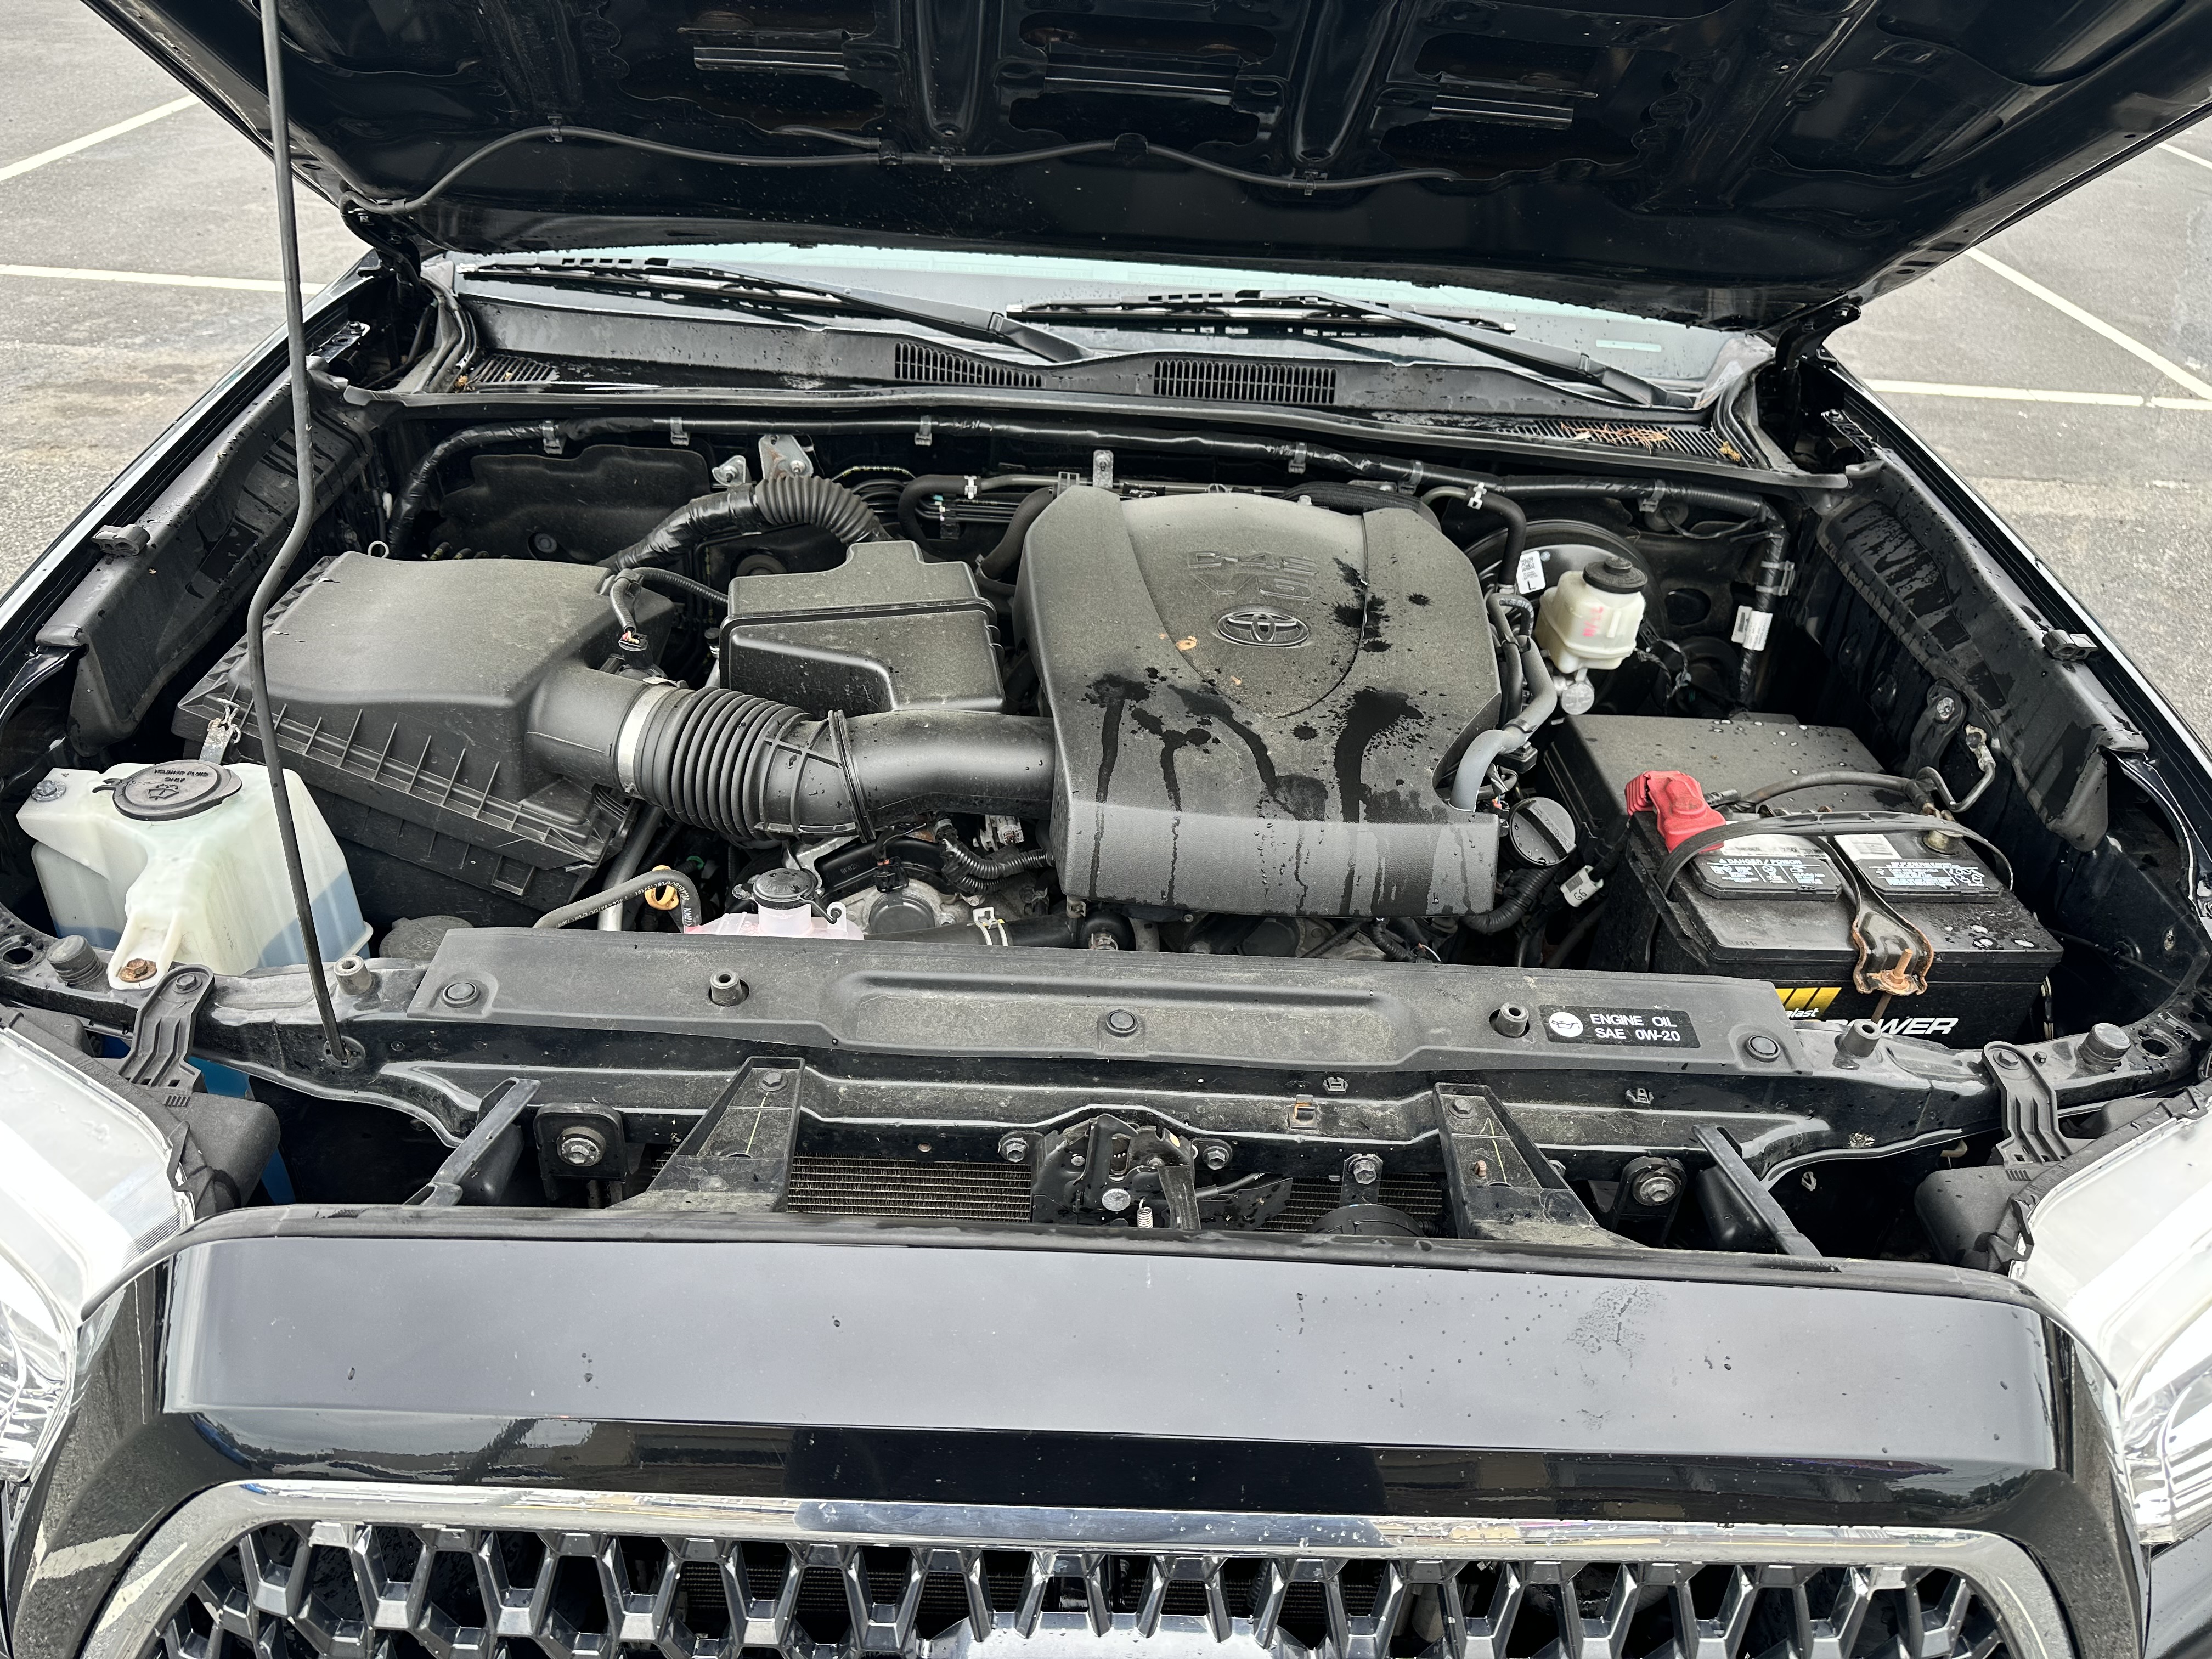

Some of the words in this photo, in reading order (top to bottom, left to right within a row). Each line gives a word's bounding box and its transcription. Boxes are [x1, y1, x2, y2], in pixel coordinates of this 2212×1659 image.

[1786, 1007, 1819, 1018] alast
[1590, 1013, 1644, 1026] ENGINE
[1652, 1016, 1678, 1028] OIL
[1826, 1018, 1959, 1035] WER
[1595, 1028, 1627, 1039] SAE
[1635, 1029, 1681, 1041] 0W-20
